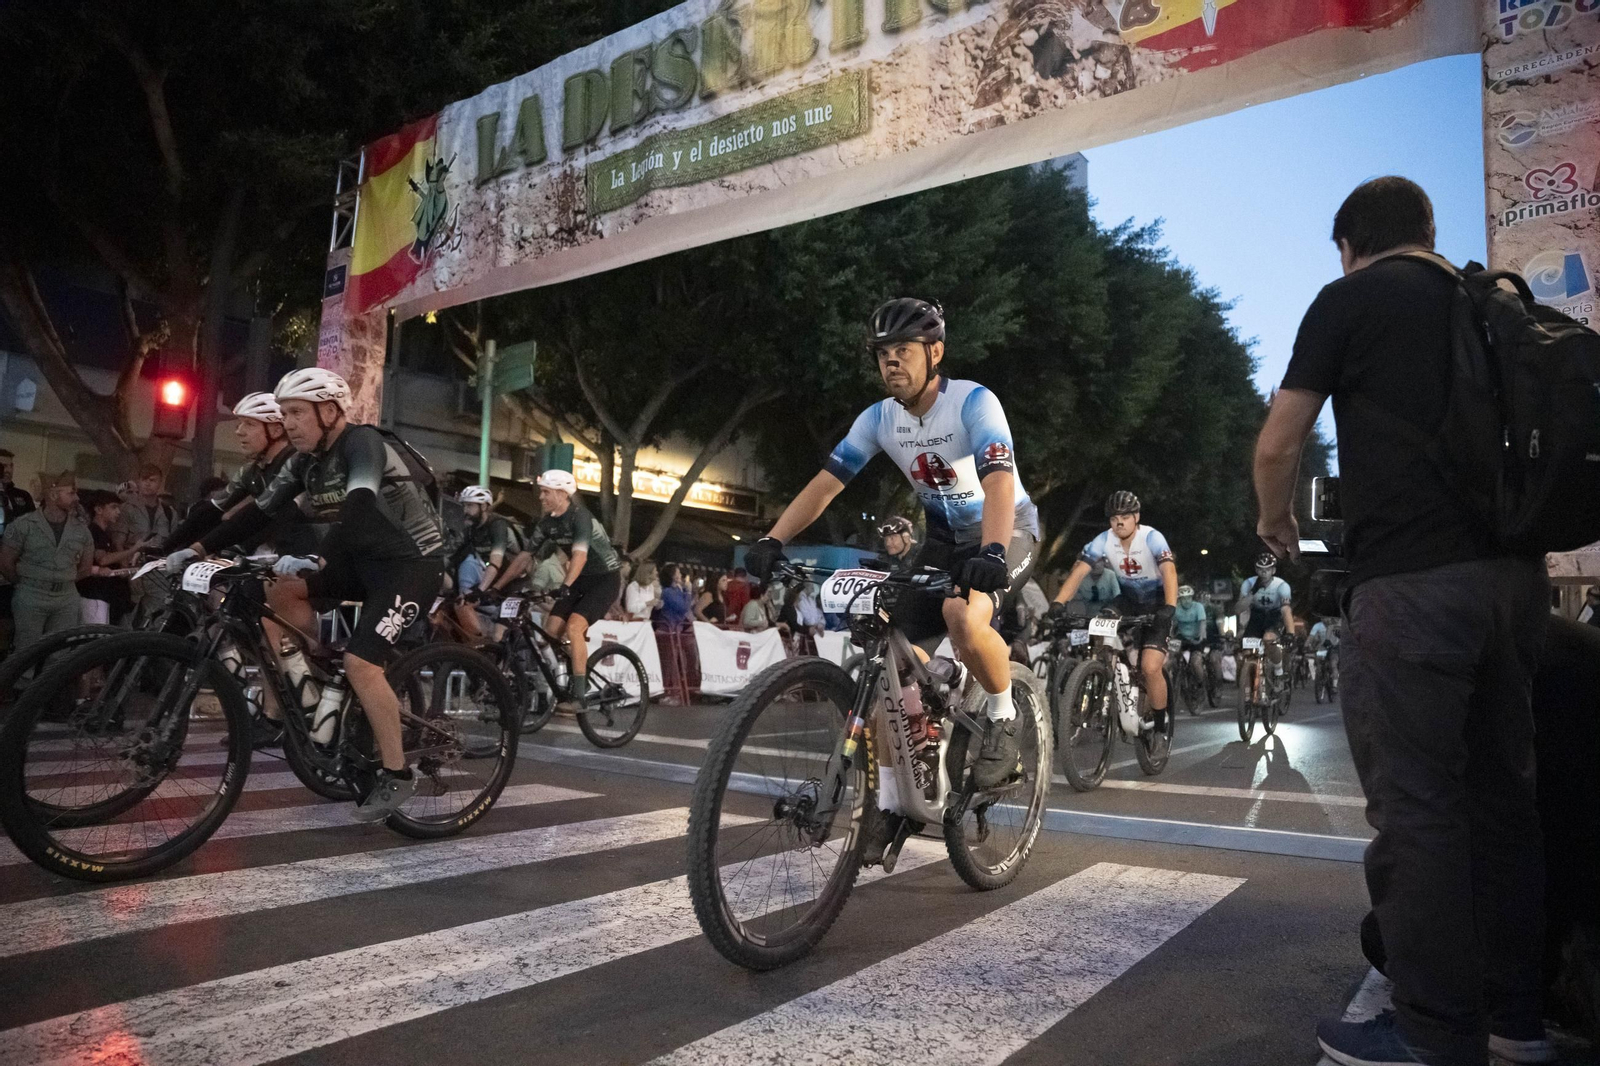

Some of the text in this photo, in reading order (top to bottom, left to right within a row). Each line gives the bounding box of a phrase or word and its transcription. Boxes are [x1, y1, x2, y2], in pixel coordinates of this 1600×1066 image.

[475, 93, 548, 190] LA
[610, 104, 833, 190] La Legión y el desierto nos une
[898, 433, 954, 448] VITALDENT
[458, 795, 492, 826] MAXXIS
